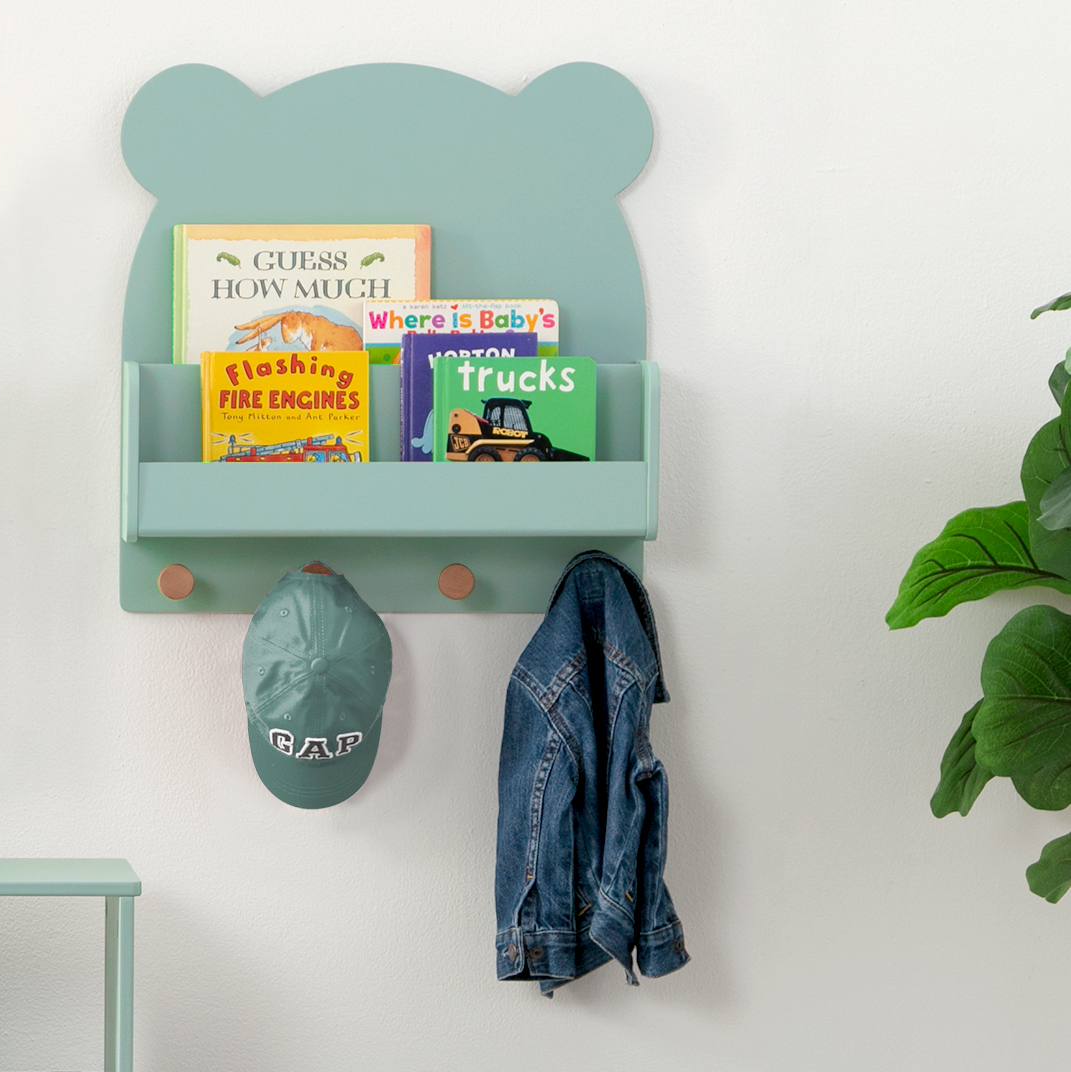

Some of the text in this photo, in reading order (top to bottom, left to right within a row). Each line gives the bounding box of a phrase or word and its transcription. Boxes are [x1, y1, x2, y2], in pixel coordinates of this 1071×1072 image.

[253, 251, 348, 271] GUESS
[211, 278, 391, 299] HOW MUCH
[368, 310, 446, 330] Where
[479, 308, 556, 333] Baby's
[225, 353, 354, 390] Flashing
[457, 359, 576, 393] trucks
[219, 390, 360, 410] FIRE ENGINES
[222, 412, 244, 423] Tony
[305, 412, 323, 420] Ant
[492, 426, 528, 439] ROBOT
[453, 436, 470, 450] JCB
[269, 728, 363, 759] GAP
